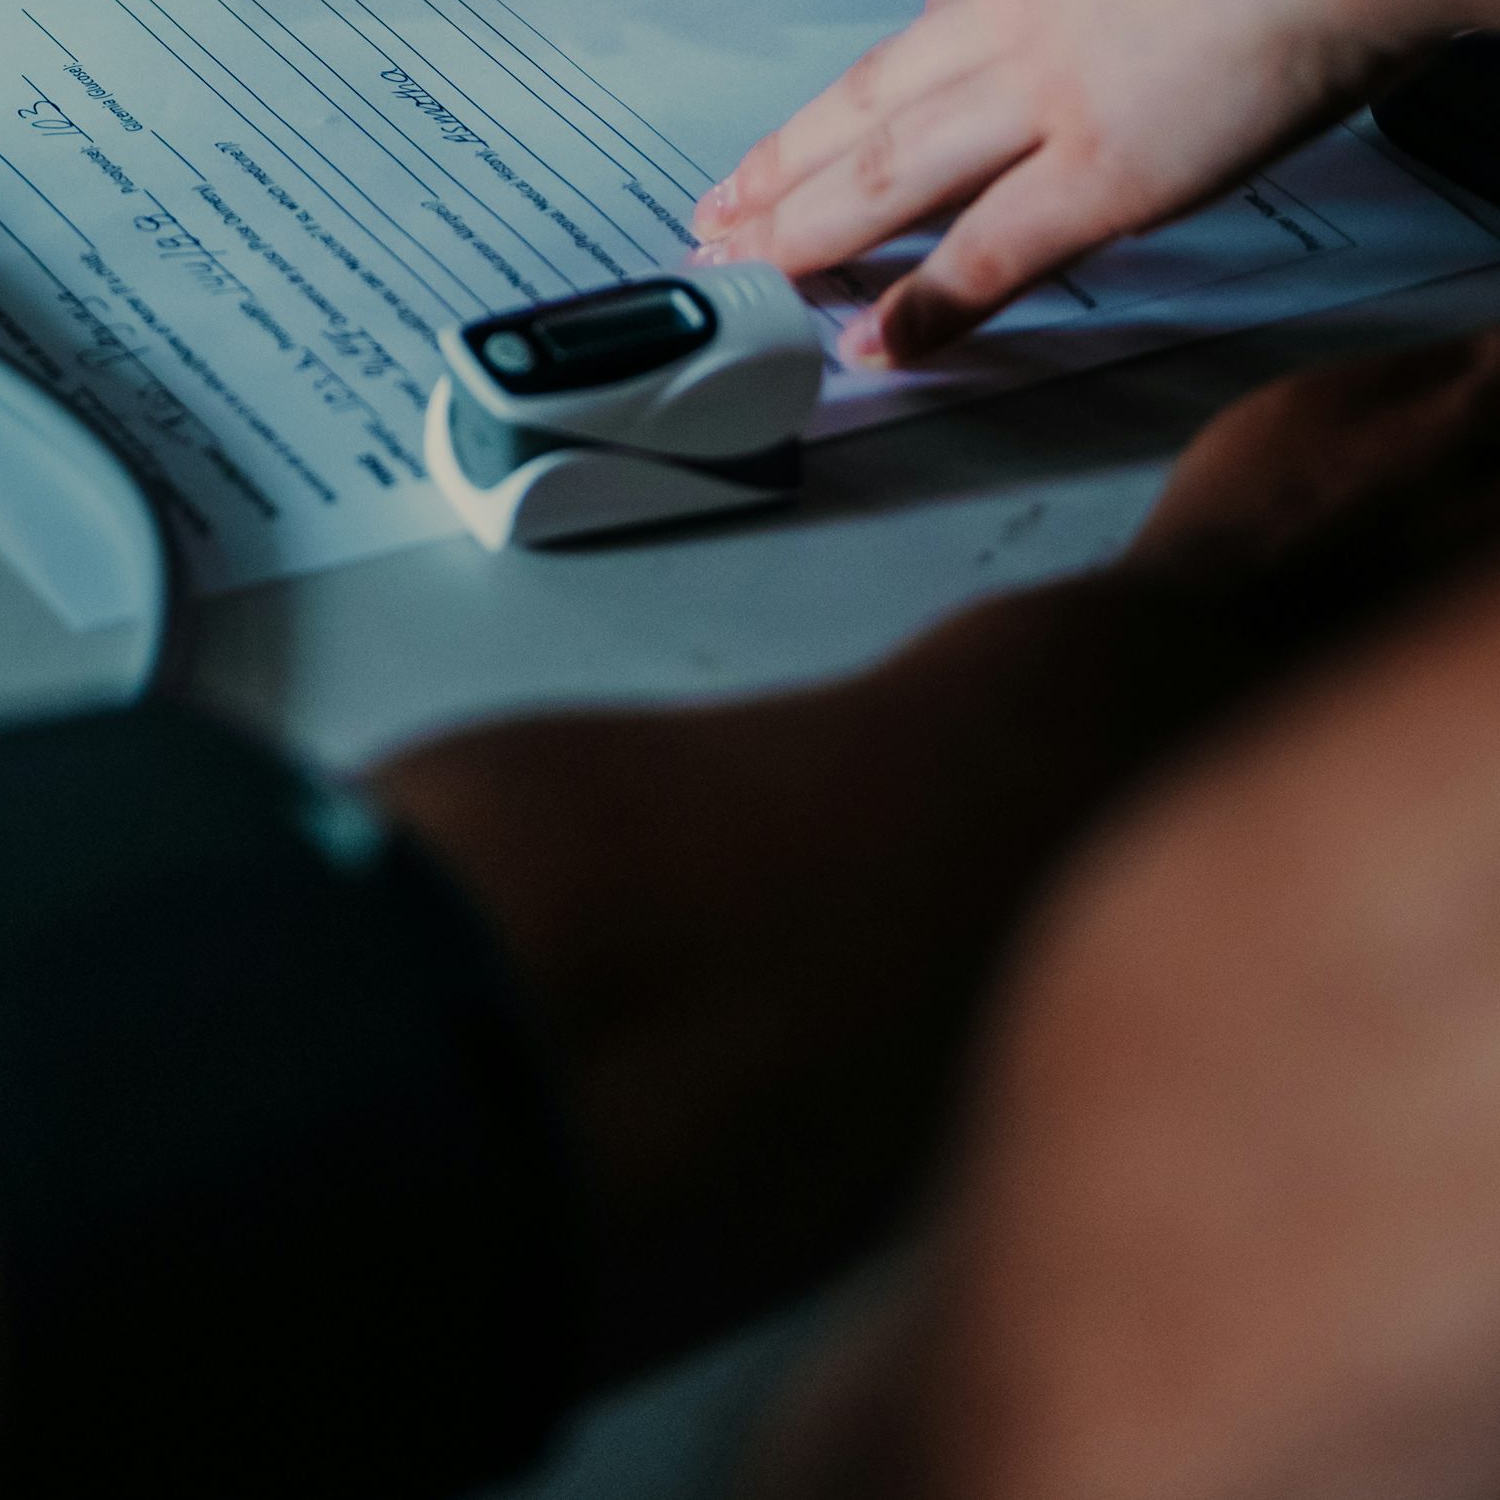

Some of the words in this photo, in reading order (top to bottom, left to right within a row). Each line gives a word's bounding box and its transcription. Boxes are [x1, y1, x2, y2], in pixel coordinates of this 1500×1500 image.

[62, 55, 113, 105] (Glucose):
[16, 99, 80, 136] 103
[101, 93, 143, 132] Glicemia
